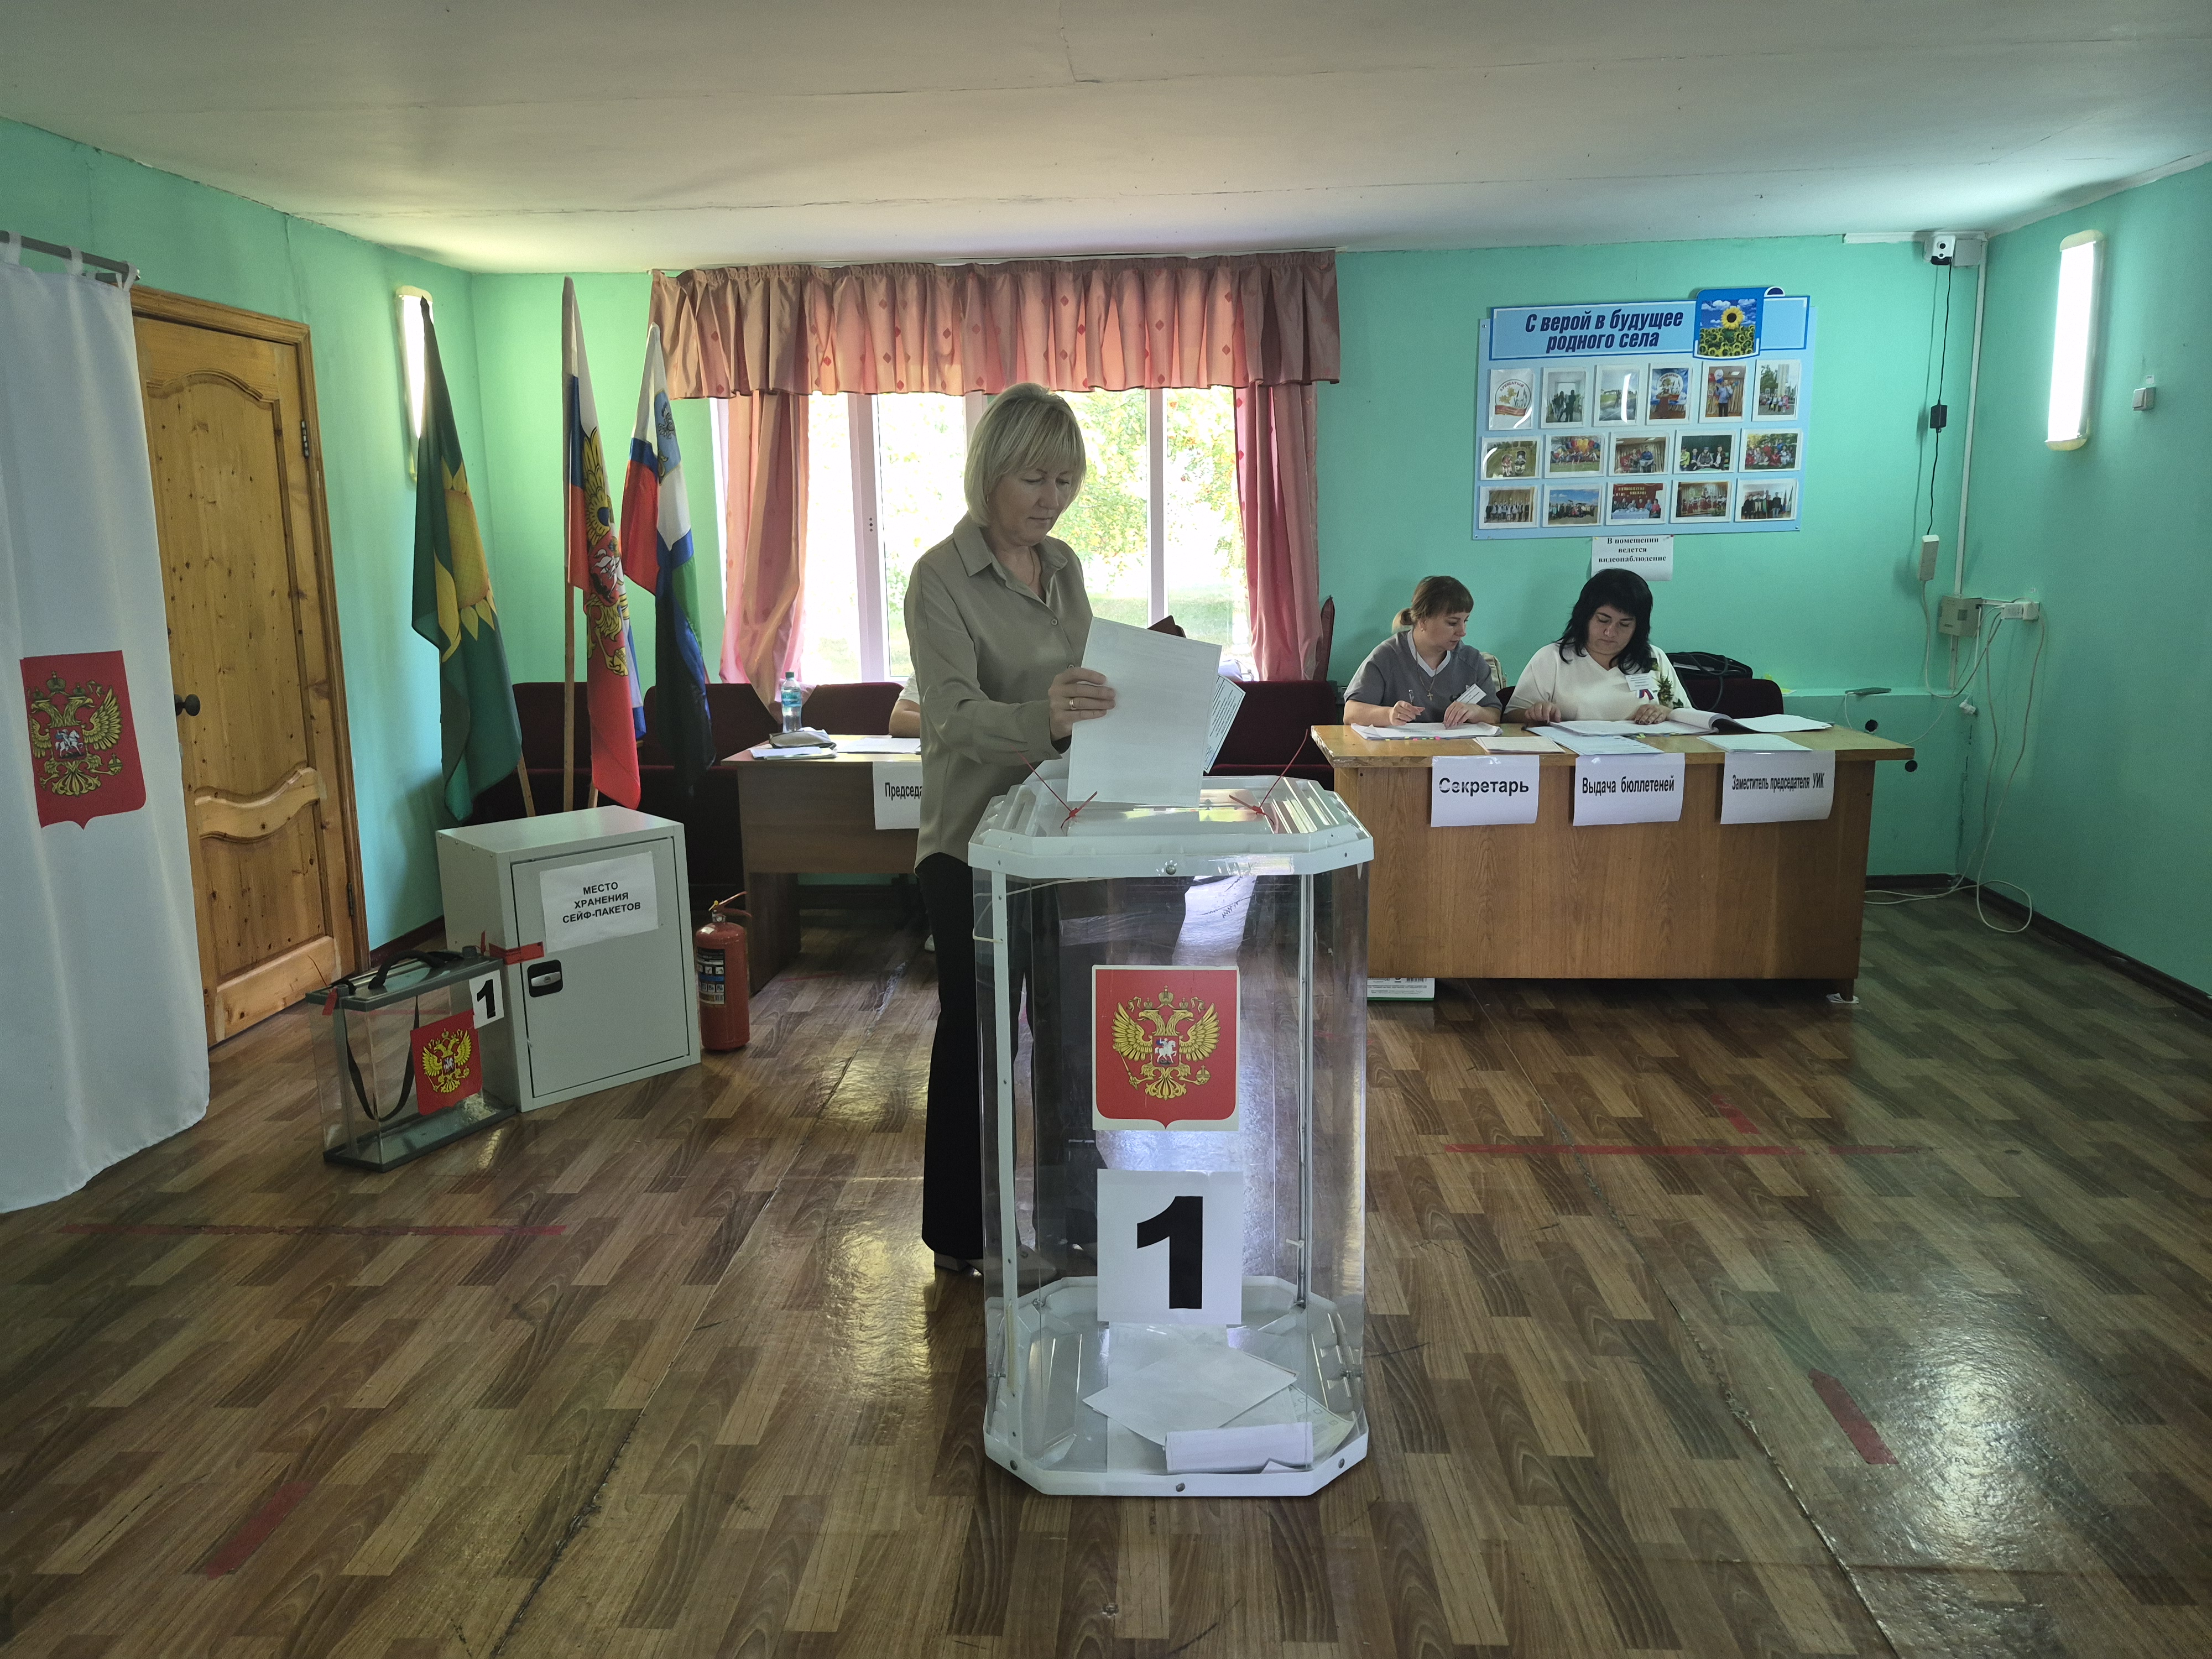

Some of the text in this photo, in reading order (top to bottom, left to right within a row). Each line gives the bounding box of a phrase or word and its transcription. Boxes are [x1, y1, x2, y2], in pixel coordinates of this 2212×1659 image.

[1525, 309, 1684, 334] С верой в будущее
[1546, 332, 1660, 354] родного села
[1439, 778, 1529, 796] Секретарь
[1582, 775, 1674, 796] Выдача бюллетеней
[1732, 773, 1825, 793] Заместитель председателя УИК
[583, 881, 619, 895] МЕСТО
[574, 892, 629, 909] ХРАНЕНИЯ
[562, 902, 641, 923] СЕЙФ-ПАКЕТОВ
[477, 979, 496, 1019] 1
[1137, 1196, 1203, 1309] 1
